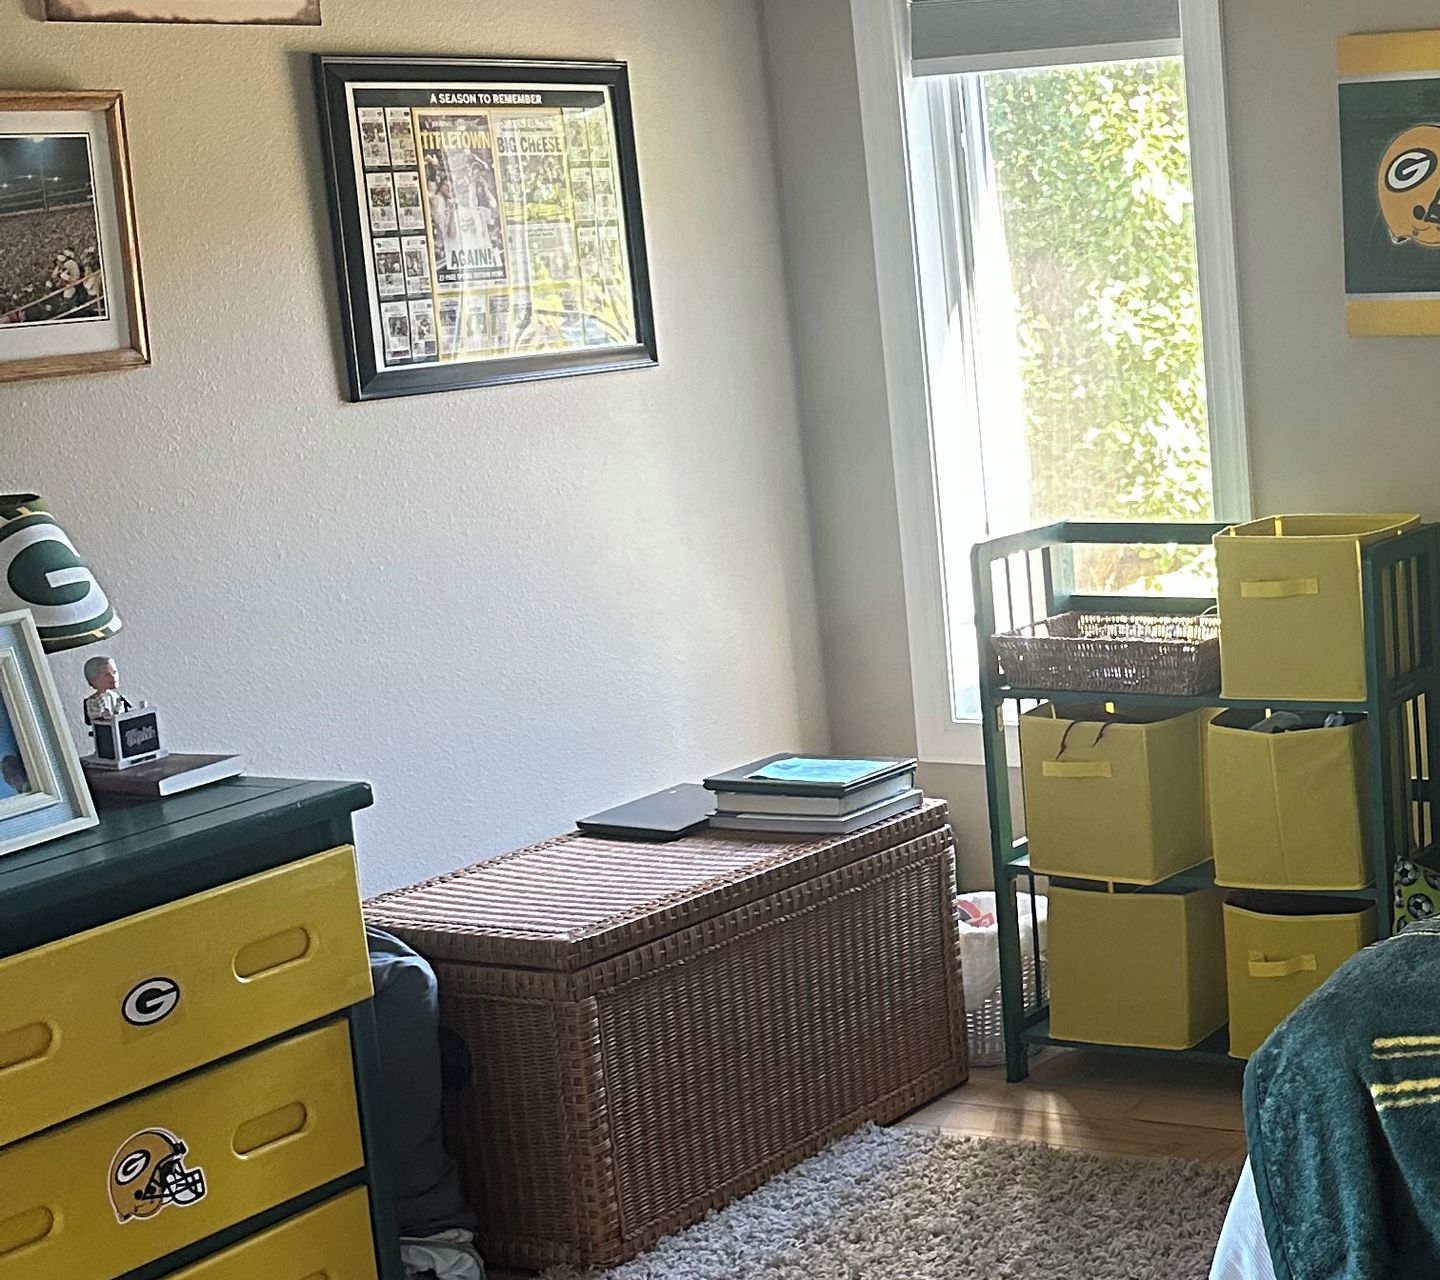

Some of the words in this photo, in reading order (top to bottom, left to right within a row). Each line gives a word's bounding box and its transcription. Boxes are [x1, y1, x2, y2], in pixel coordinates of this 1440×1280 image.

[430, 94, 438, 104] A
[438, 93, 477, 105] SEASON
[477, 93, 491, 104] TO
[492, 93, 543, 105] REMEMBER
[421, 131, 491, 150] TITLETOWN
[496, 137, 518, 153] BIG
[520, 136, 562, 153] CHEESE
[451, 248, 492, 268] AGAIN!
